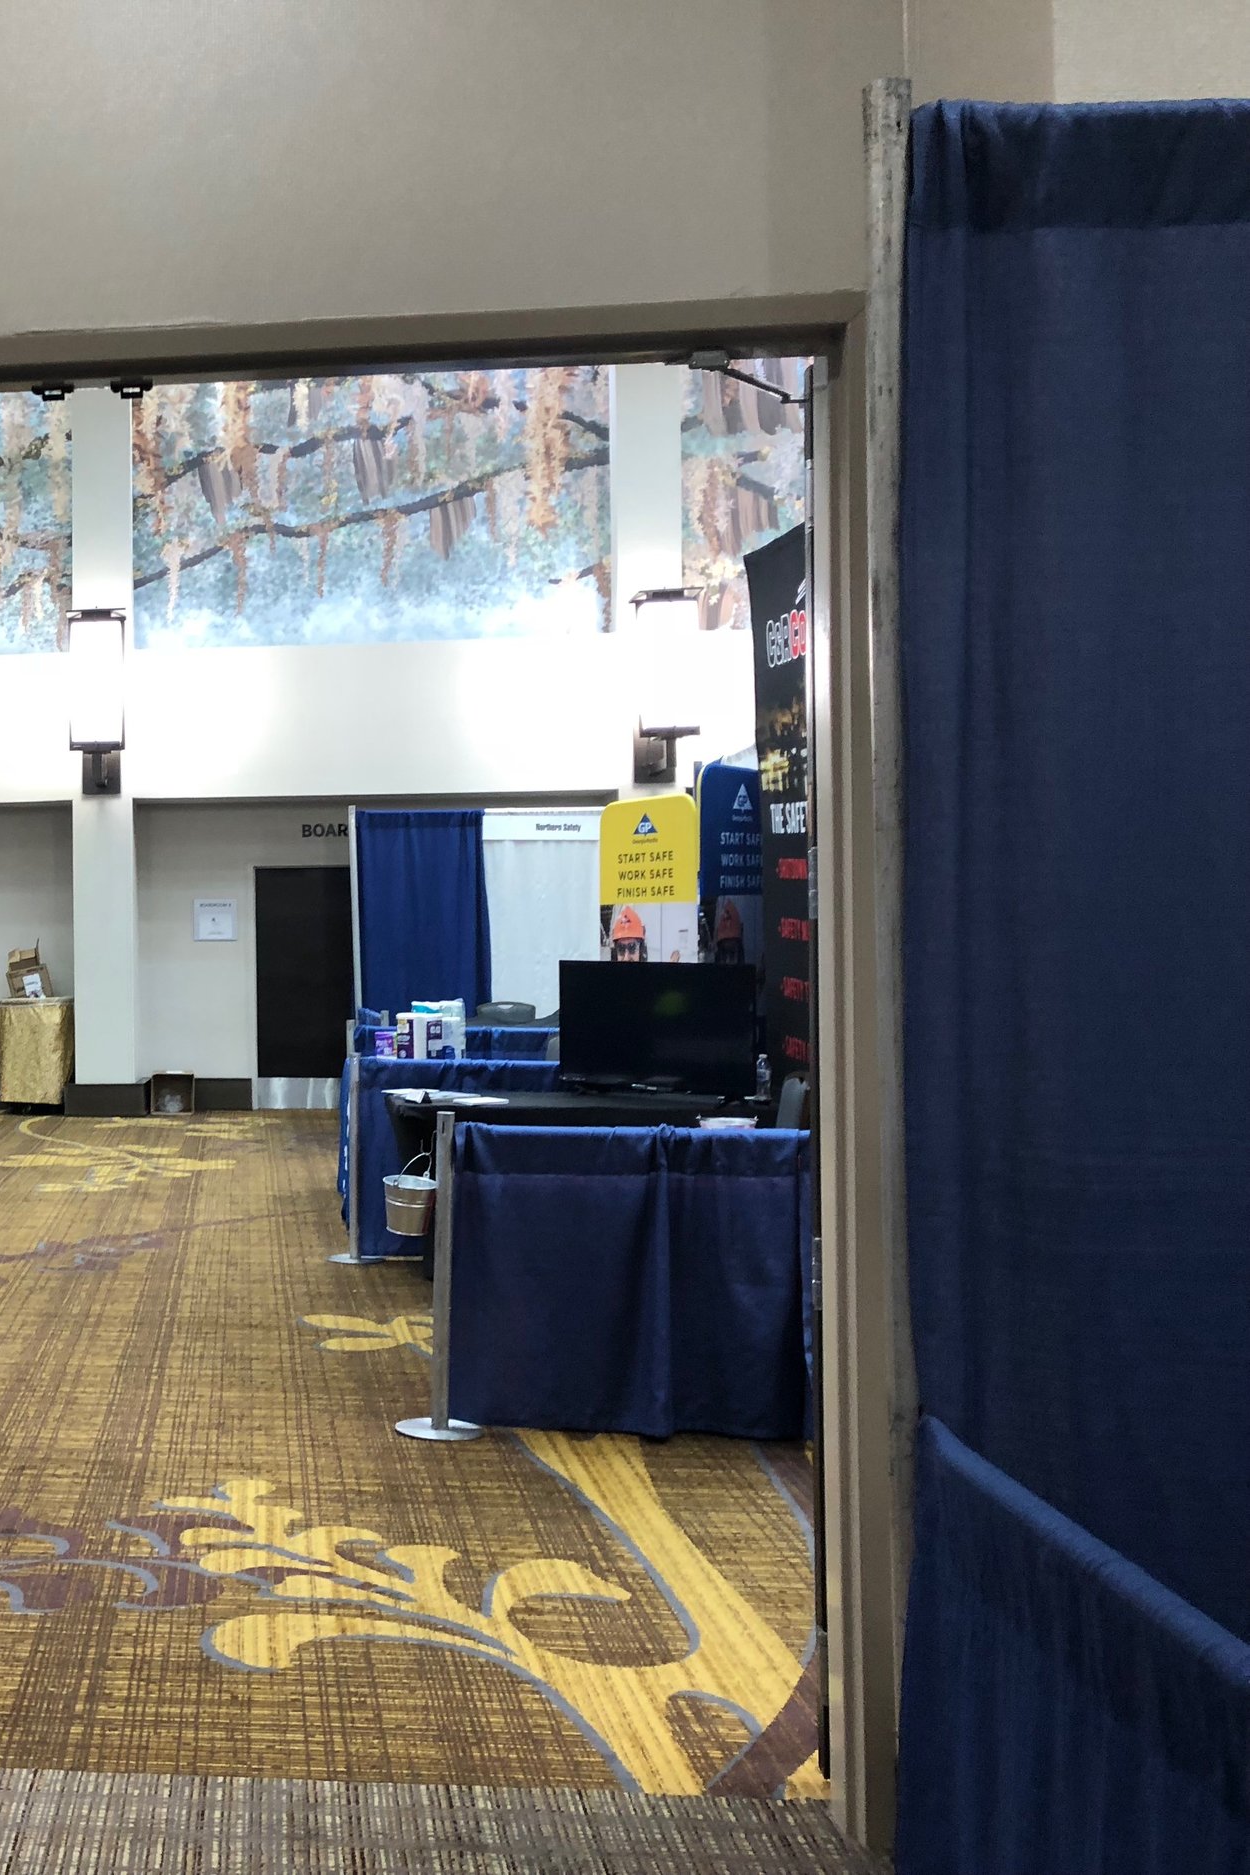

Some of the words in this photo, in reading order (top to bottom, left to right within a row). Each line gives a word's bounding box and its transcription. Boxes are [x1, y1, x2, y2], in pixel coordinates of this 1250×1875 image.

[769, 803, 785, 834] THE
[535, 823, 562, 832] Northern
[563, 823, 581, 833] Safety
[638, 822, 652, 834] GP
[720, 831, 745, 845] START
[617, 852, 646, 864] START
[649, 850, 674, 862] SAFE
[720, 854, 744, 867] WORK
[618, 869, 646, 881] WORK
[649, 867, 674, 879] SAFE
[720, 875, 745, 889] FINISH
[617, 887, 648, 898] FINISH
[650, 884, 675, 897] SAFE
